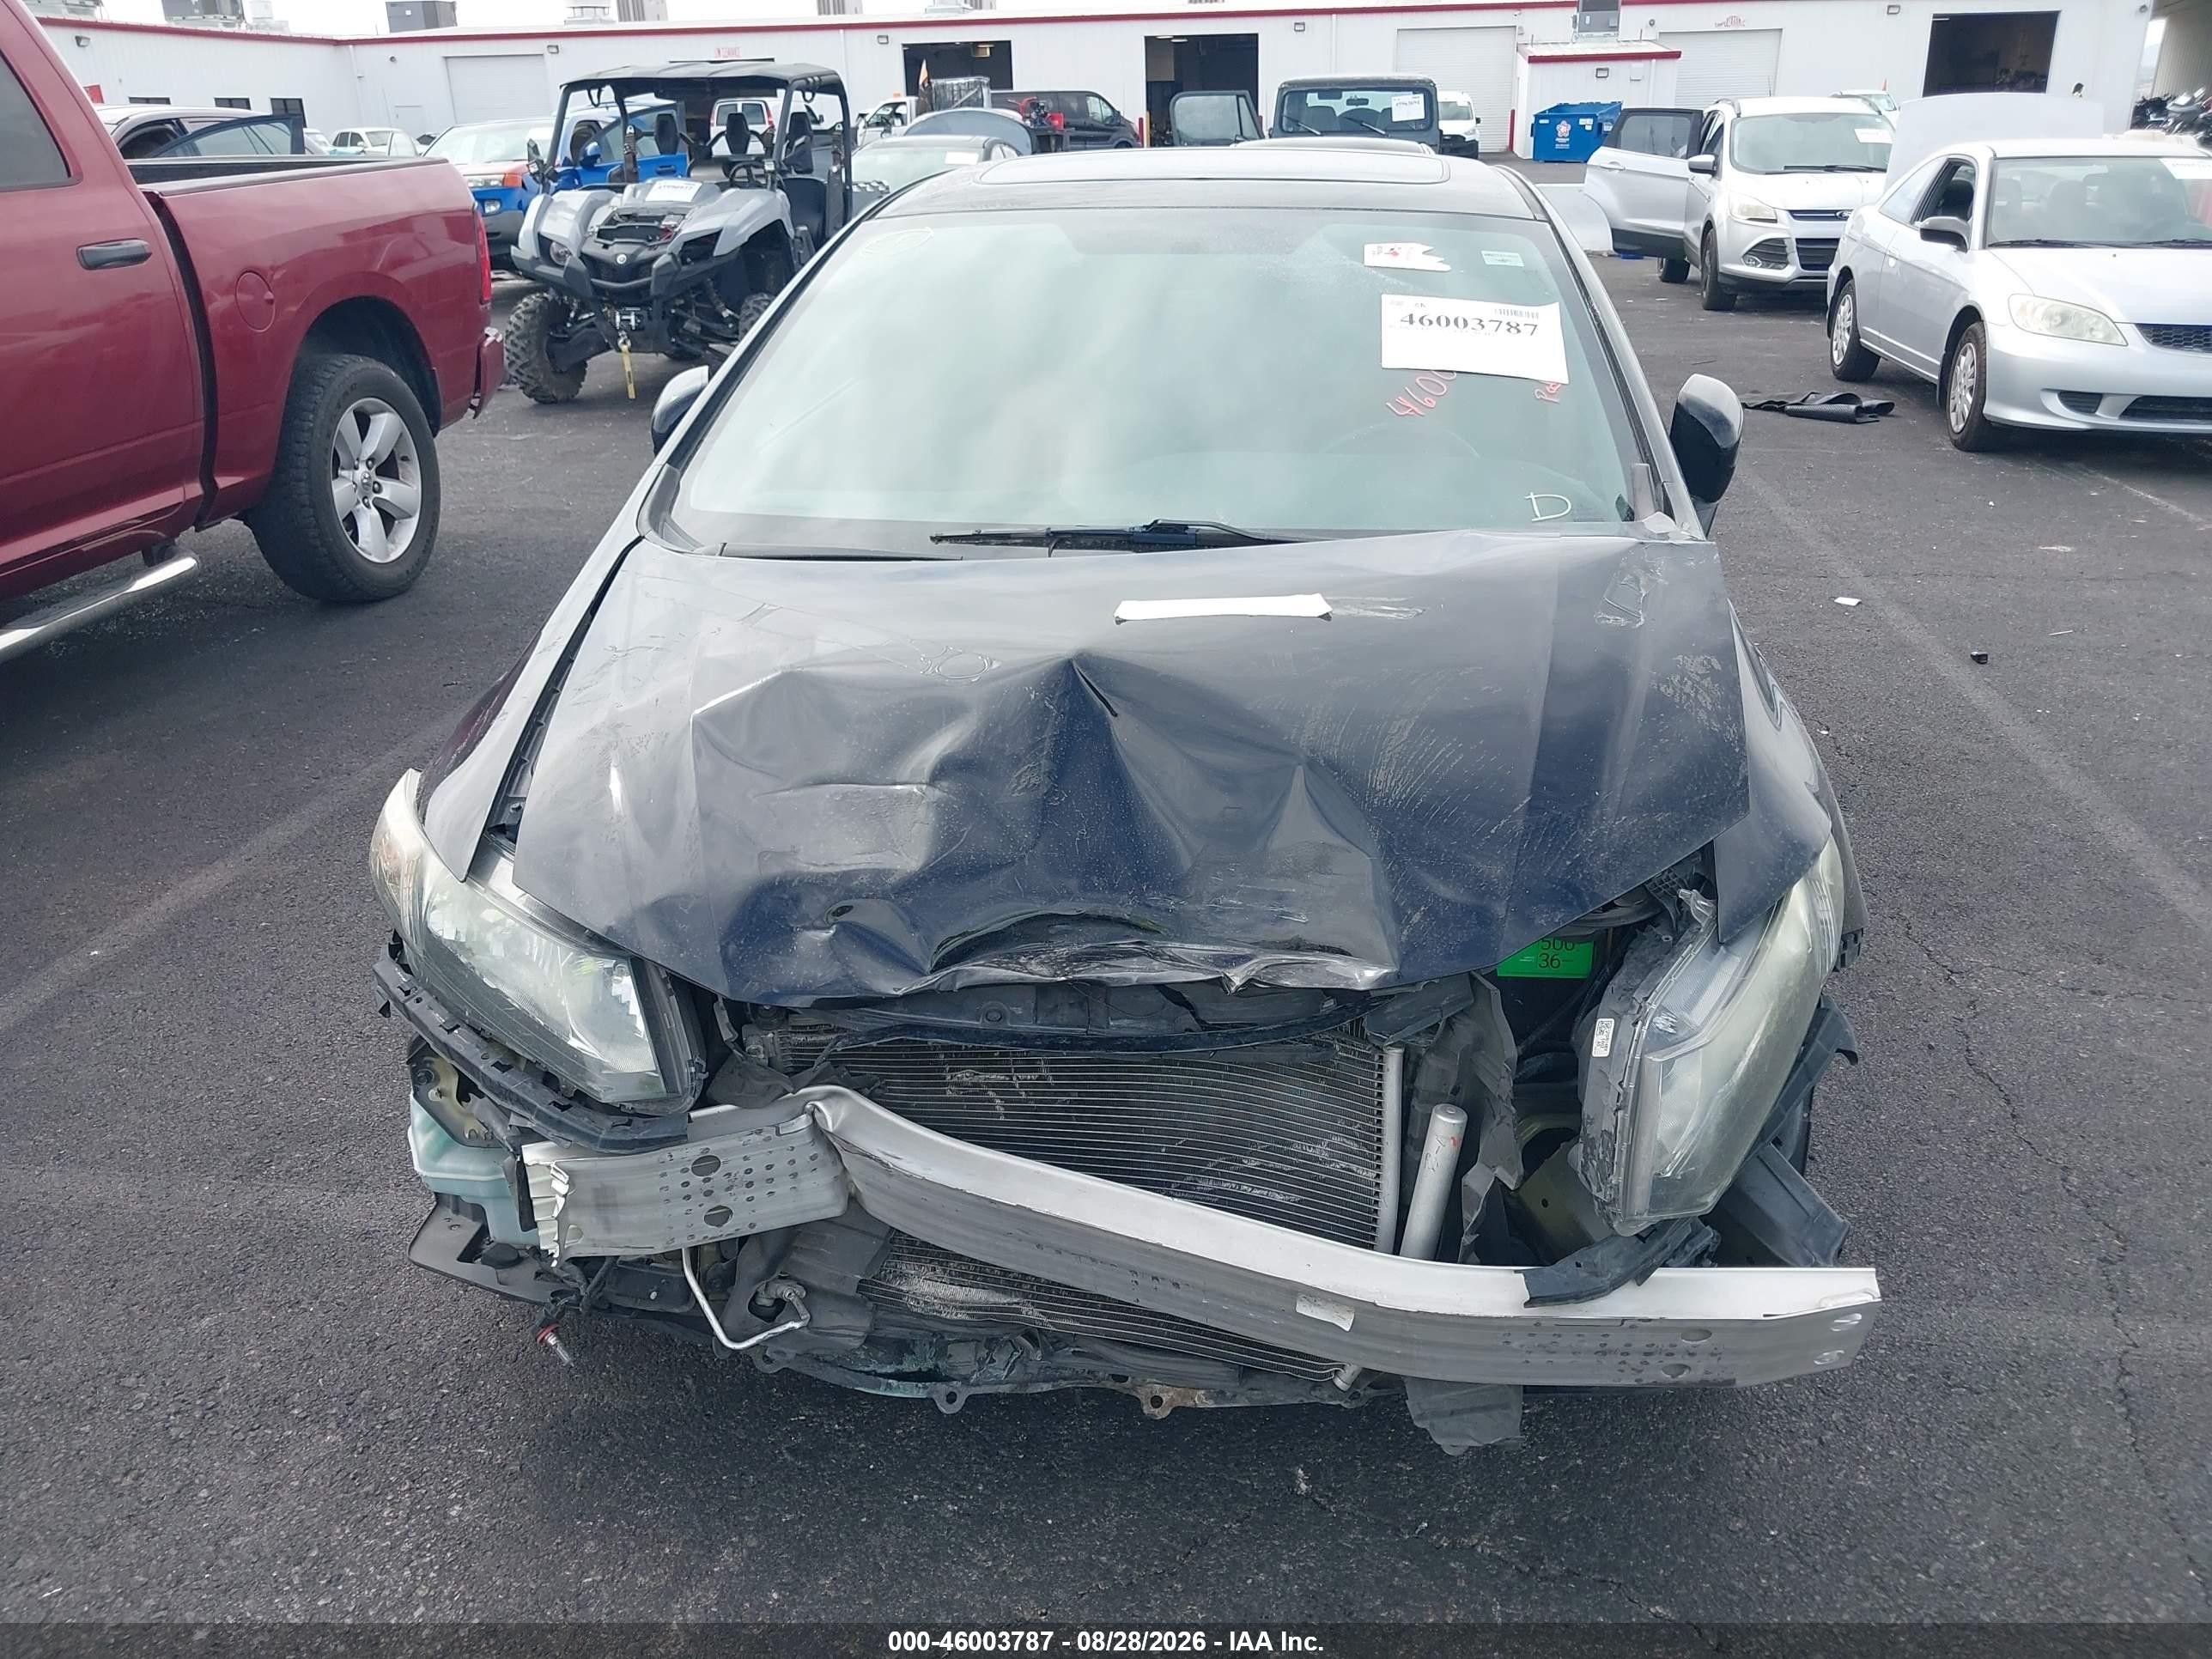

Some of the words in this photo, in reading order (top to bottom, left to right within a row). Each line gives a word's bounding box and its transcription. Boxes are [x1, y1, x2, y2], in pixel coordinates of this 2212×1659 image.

[1400, 313, 1539, 337] 46003787
[1524, 492, 1572, 522] D
[1539, 952, 1561, 969] 36
